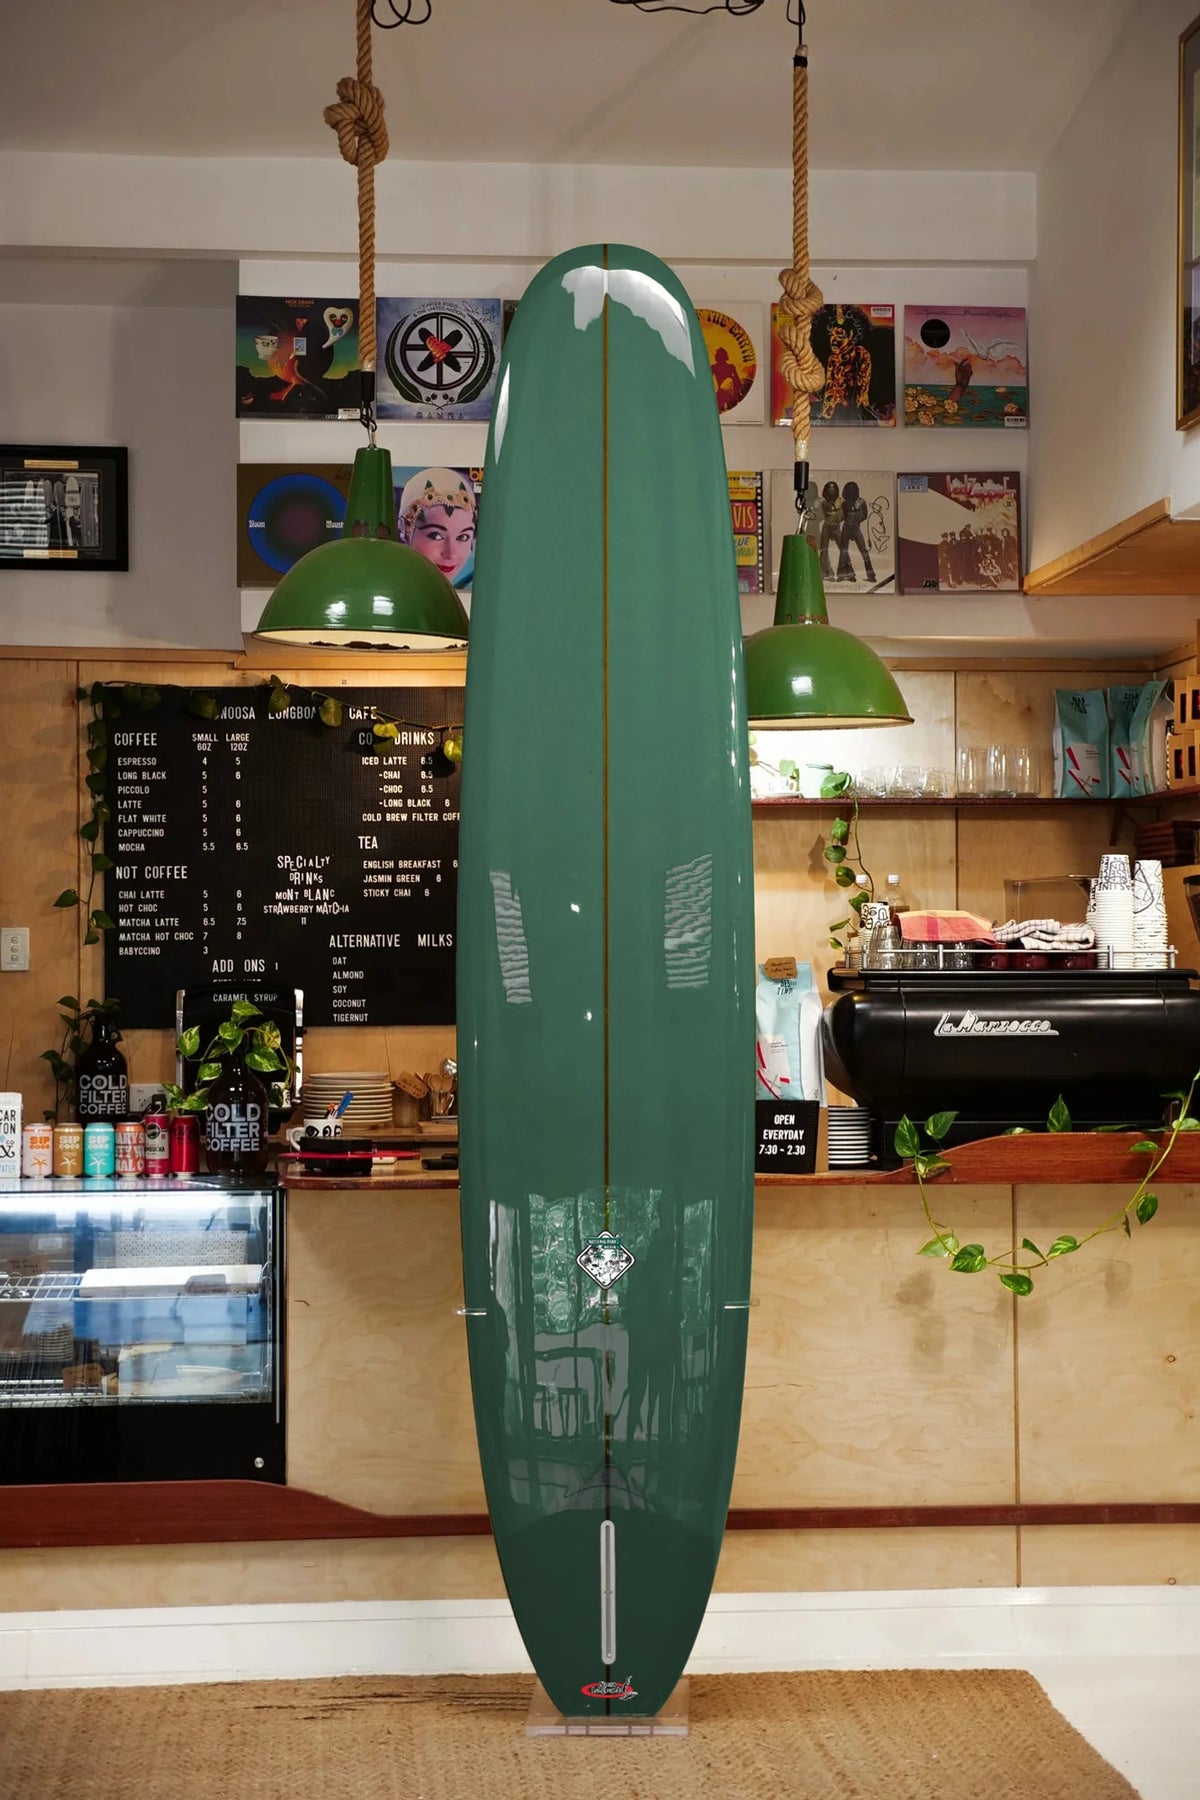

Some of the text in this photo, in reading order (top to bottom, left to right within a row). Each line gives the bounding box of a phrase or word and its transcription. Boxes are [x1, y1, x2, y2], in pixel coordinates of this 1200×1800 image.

[221, 706, 256, 720] NOOSA
[349, 706, 378, 720] CAFE
[114, 733, 158, 746] COFFEE
[192, 733, 250, 742] SMALL LARGE
[358, 731, 435, 746] CO DRINKS
[118, 757, 241, 766] ESPRESSO 4 5
[361, 756, 433, 766] ICED LATTE 6.5
[118, 771, 241, 780] LONG BLACK 5 6
[420, 770, 434, 780] 6.5
[118, 785, 208, 795] PICCOLO 5
[420, 784, 434, 794] 6.5
[118, 800, 242, 809] LATTE 5 6
[407, 799, 432, 808] BLACK
[444, 799, 451, 808] 6
[118, 814, 242, 824] FLAT WHITE 5 6
[362, 812, 382, 822] COLD
[386, 812, 408, 822] BREW
[412, 812, 439, 822] FILTER
[118, 828, 242, 838] CAPPUCCINO 5 6
[118, 842, 249, 852] MOCHA 5.5 6.5
[358, 835, 378, 850] TEA
[277, 855, 331, 871] SPECIALTY
[363, 859, 459, 869] ENGLISH BREAKFAST 6
[115, 865, 188, 879] NOT COFFEE
[289, 871, 324, 885] DRINKS
[363, 873, 442, 883] JASMIN GREEN 6
[118, 889, 242, 899] CHAI LATTE 5 6
[363, 888, 430, 898] STICKY CHAI 6
[118, 903, 242, 913] HOT CHOC 5 6
[263, 901, 314, 915] STRAWBERRY
[119, 918, 151, 927] MATCHA
[155, 918, 180, 927] LATTE
[202, 917, 216, 926] 6.5
[119, 932, 242, 942] MATCHA HOT CHOC 7 8
[329, 933, 453, 948] ALTERNATIVE MILKS
[119, 946, 209, 956] BABYCCINO 3
[212, 959, 234, 973] ADD
[244, 959, 265, 973] ONS
[332, 956, 347, 966] OAT
[332, 970, 364, 980] ALMOND
[332, 985, 347, 994] SOY
[212, 993, 278, 1002] CARAMEL SYRUP
[332, 999, 366, 1008] COCONUT
[332, 1013, 368, 1022] TIGERNUT
[955, 1009, 1058, 1036] Marzocco
[79, 1074, 128, 1090] COLD
[80, 1090, 127, 1103] FILTER
[79, 1103, 127, 1114] COFFEE
[206, 1103, 260, 1122] COLD
[774, 1114, 795, 1125] OPEN
[206, 1122, 260, 1138] FILTER
[763, 1129, 804, 1140] EVERYDAY
[29, 1135, 50, 1144] SIP
[59, 1135, 80, 1144] SIP
[206, 1138, 260, 1152] COFFEE
[759, 1144, 778, 1155] 7:30
[787, 1144, 806, 1155] 2.30
